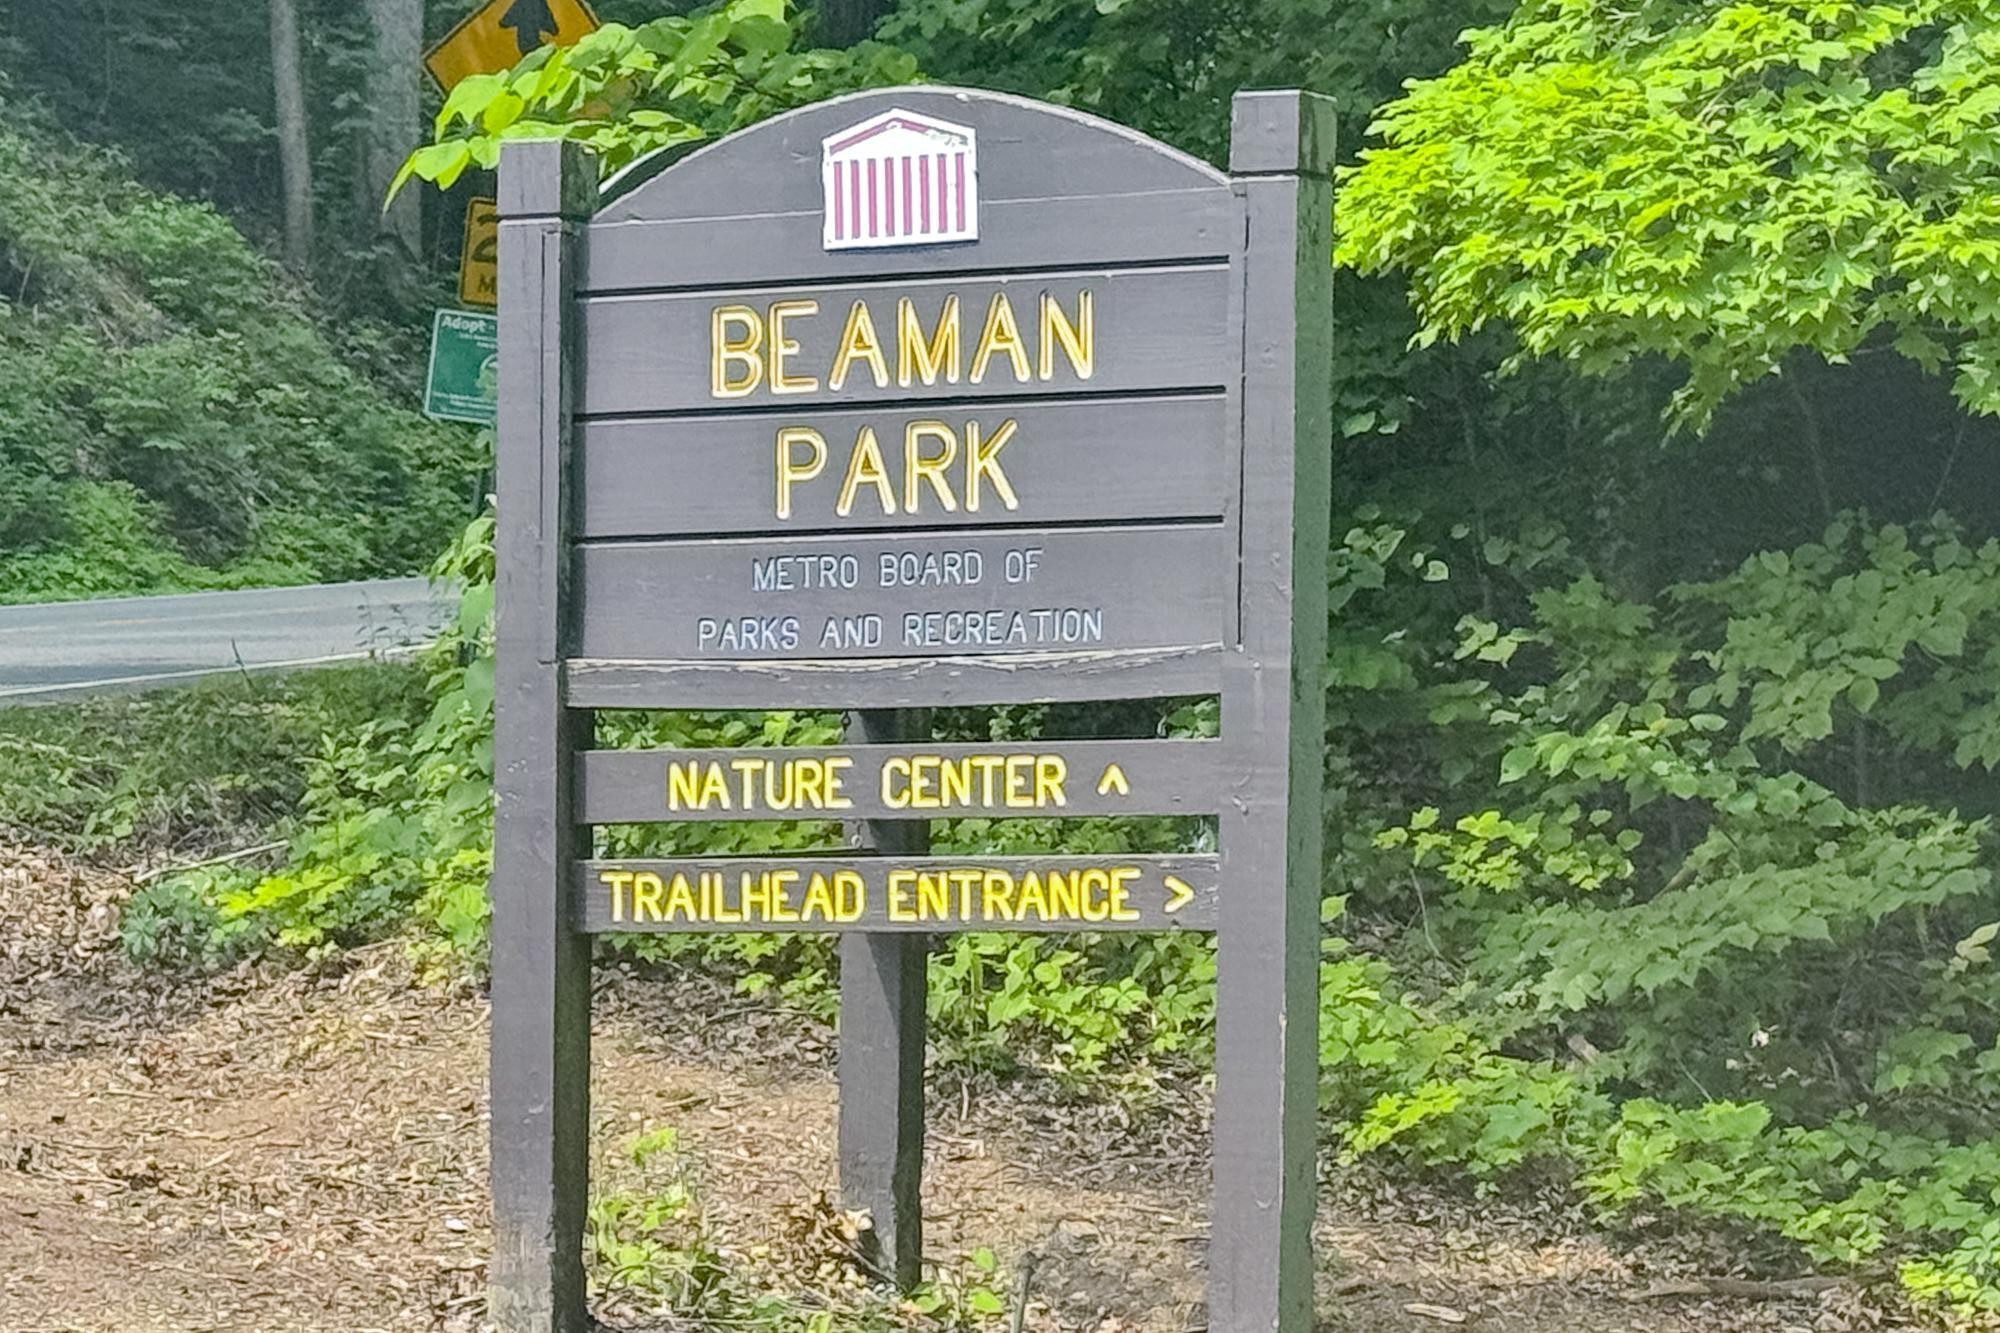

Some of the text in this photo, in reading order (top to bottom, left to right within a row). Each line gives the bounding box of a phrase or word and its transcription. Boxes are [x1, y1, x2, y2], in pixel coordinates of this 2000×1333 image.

[711, 290, 1093, 397] BEAMAN
[775, 419, 1019, 519] PARK
[752, 548, 1044, 591] METRO BOARD OF
[698, 609, 1103, 651] PARKS AND RECREATION
[668, 754, 1067, 812] NATURE CENTER
[600, 868, 1143, 923] TRAILHEAD ENTRANCE
